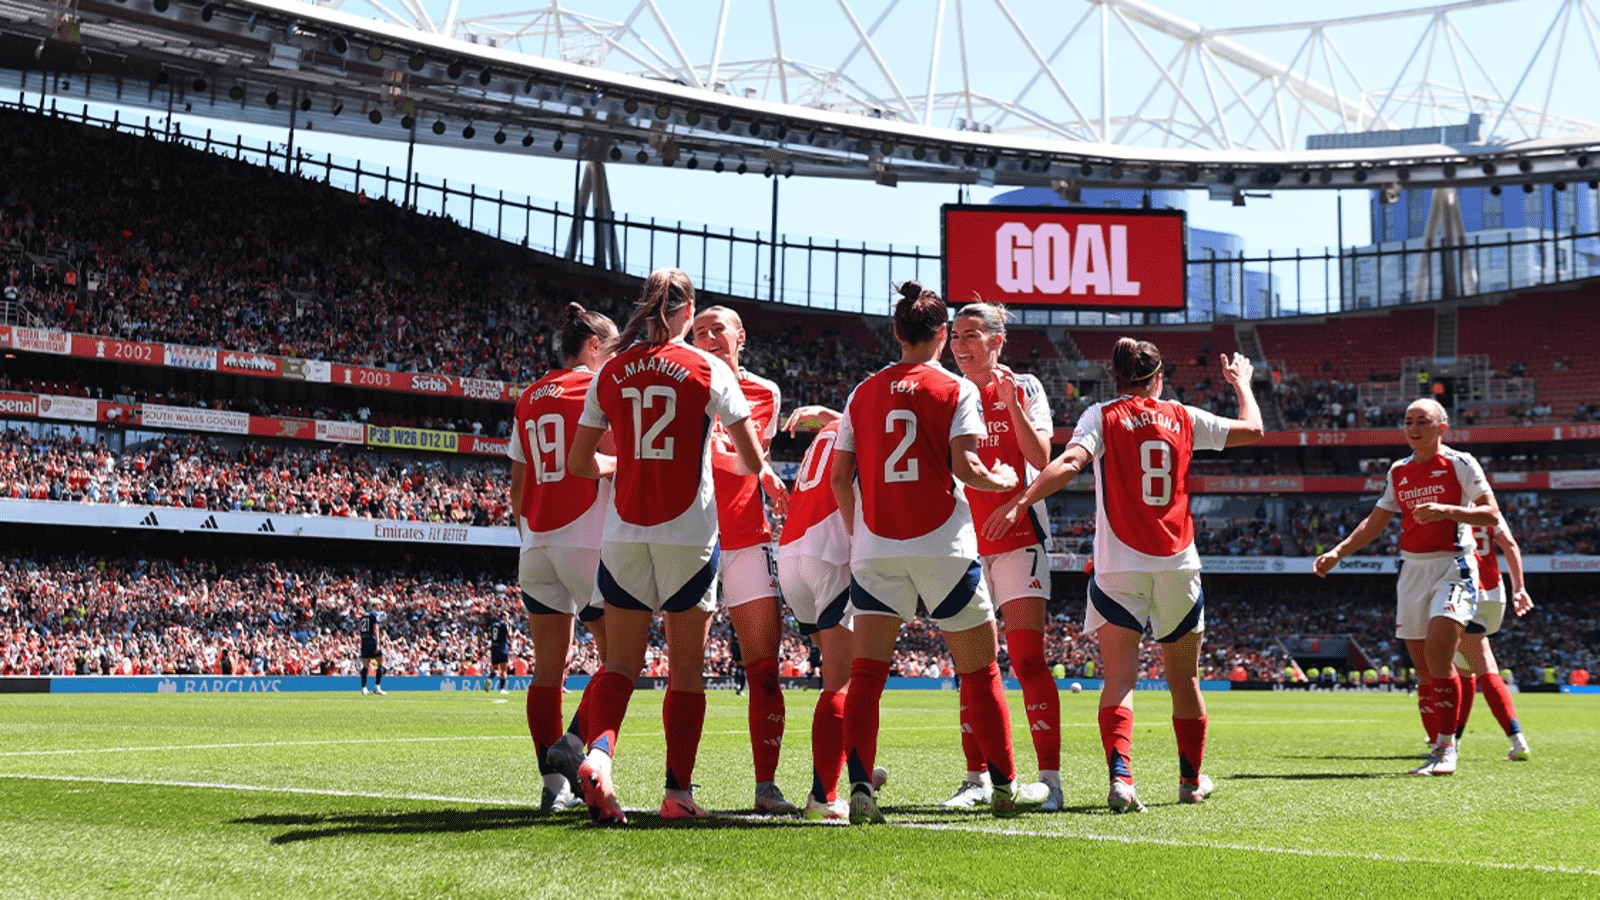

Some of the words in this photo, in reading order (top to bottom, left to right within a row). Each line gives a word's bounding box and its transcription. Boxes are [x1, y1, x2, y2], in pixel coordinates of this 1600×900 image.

[996, 222, 1141, 296] GOAL
[115, 343, 151, 360] 2002
[360, 370, 391, 386] 2003
[612, 355, 691, 384] L.MAANUM
[411, 376, 446, 392] Serbia
[890, 381, 919, 395] FOX
[464, 388, 500, 400] POLAND
[530, 384, 565, 405] FOORD
[0, 398, 37, 414] senal
[143, 411, 173, 421] SOUTH
[176, 414, 204, 424] WALES
[206, 417, 247, 427] GOONERS
[621, 385, 677, 460] 12
[1121, 410, 1181, 435] MARIONA
[369, 427, 391, 443] P38
[394, 430, 417, 445] W26
[976, 435, 1000, 448] ETTER
[472, 438, 508, 454] Arsena
[525, 414, 566, 486] 19
[884, 409, 919, 483] 2
[1140, 440, 1173, 506] 8
[1398, 484, 1446, 502] Emirates
[374, 524, 424, 540] Emirates
[428, 527, 441, 540] FLY
[442, 528, 468, 541] BETTER
[1025, 548, 1038, 577] 7
[1340, 560, 1383, 571] betway
[361, 618, 370, 632] 21
[185, 680, 281, 692] BARCLAYS
[462, 679, 531, 691] BARCLAY
